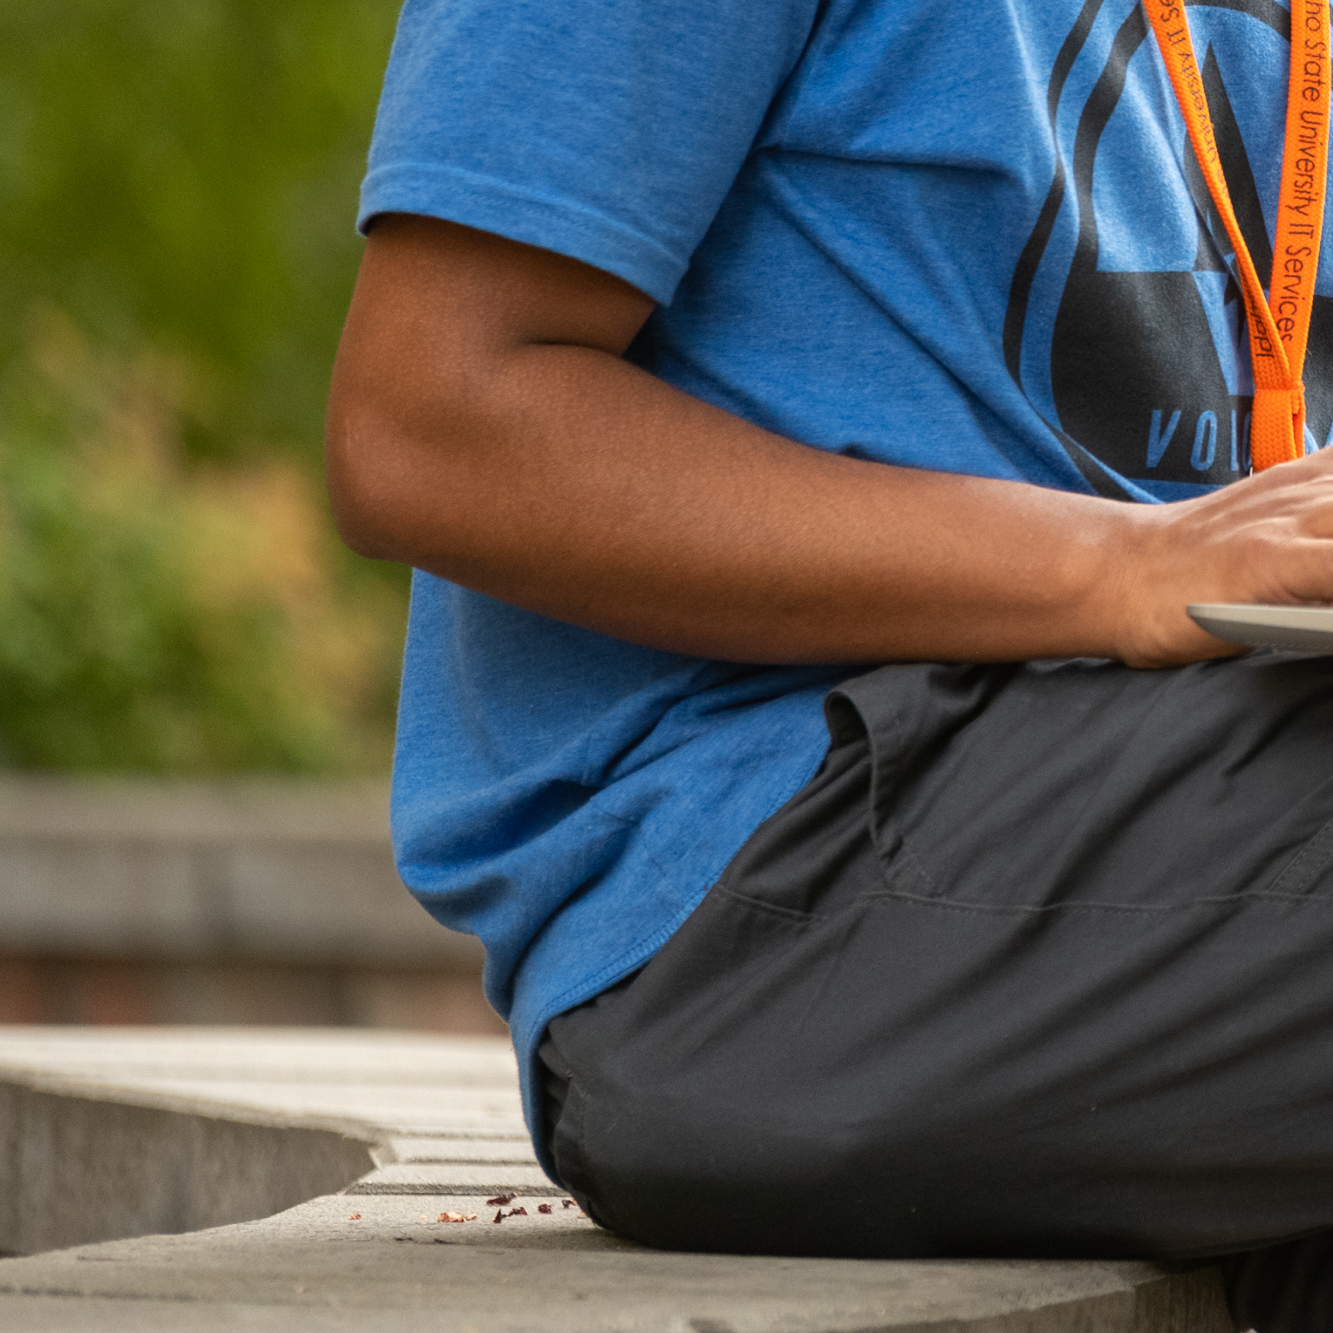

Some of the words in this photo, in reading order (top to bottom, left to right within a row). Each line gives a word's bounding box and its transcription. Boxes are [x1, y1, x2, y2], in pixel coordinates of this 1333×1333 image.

[1166, 27, 1186, 47] IT
[1304, 36, 1327, 102] State
[1284, 107, 1325, 215] University
[1289, 217, 1316, 241] IT
